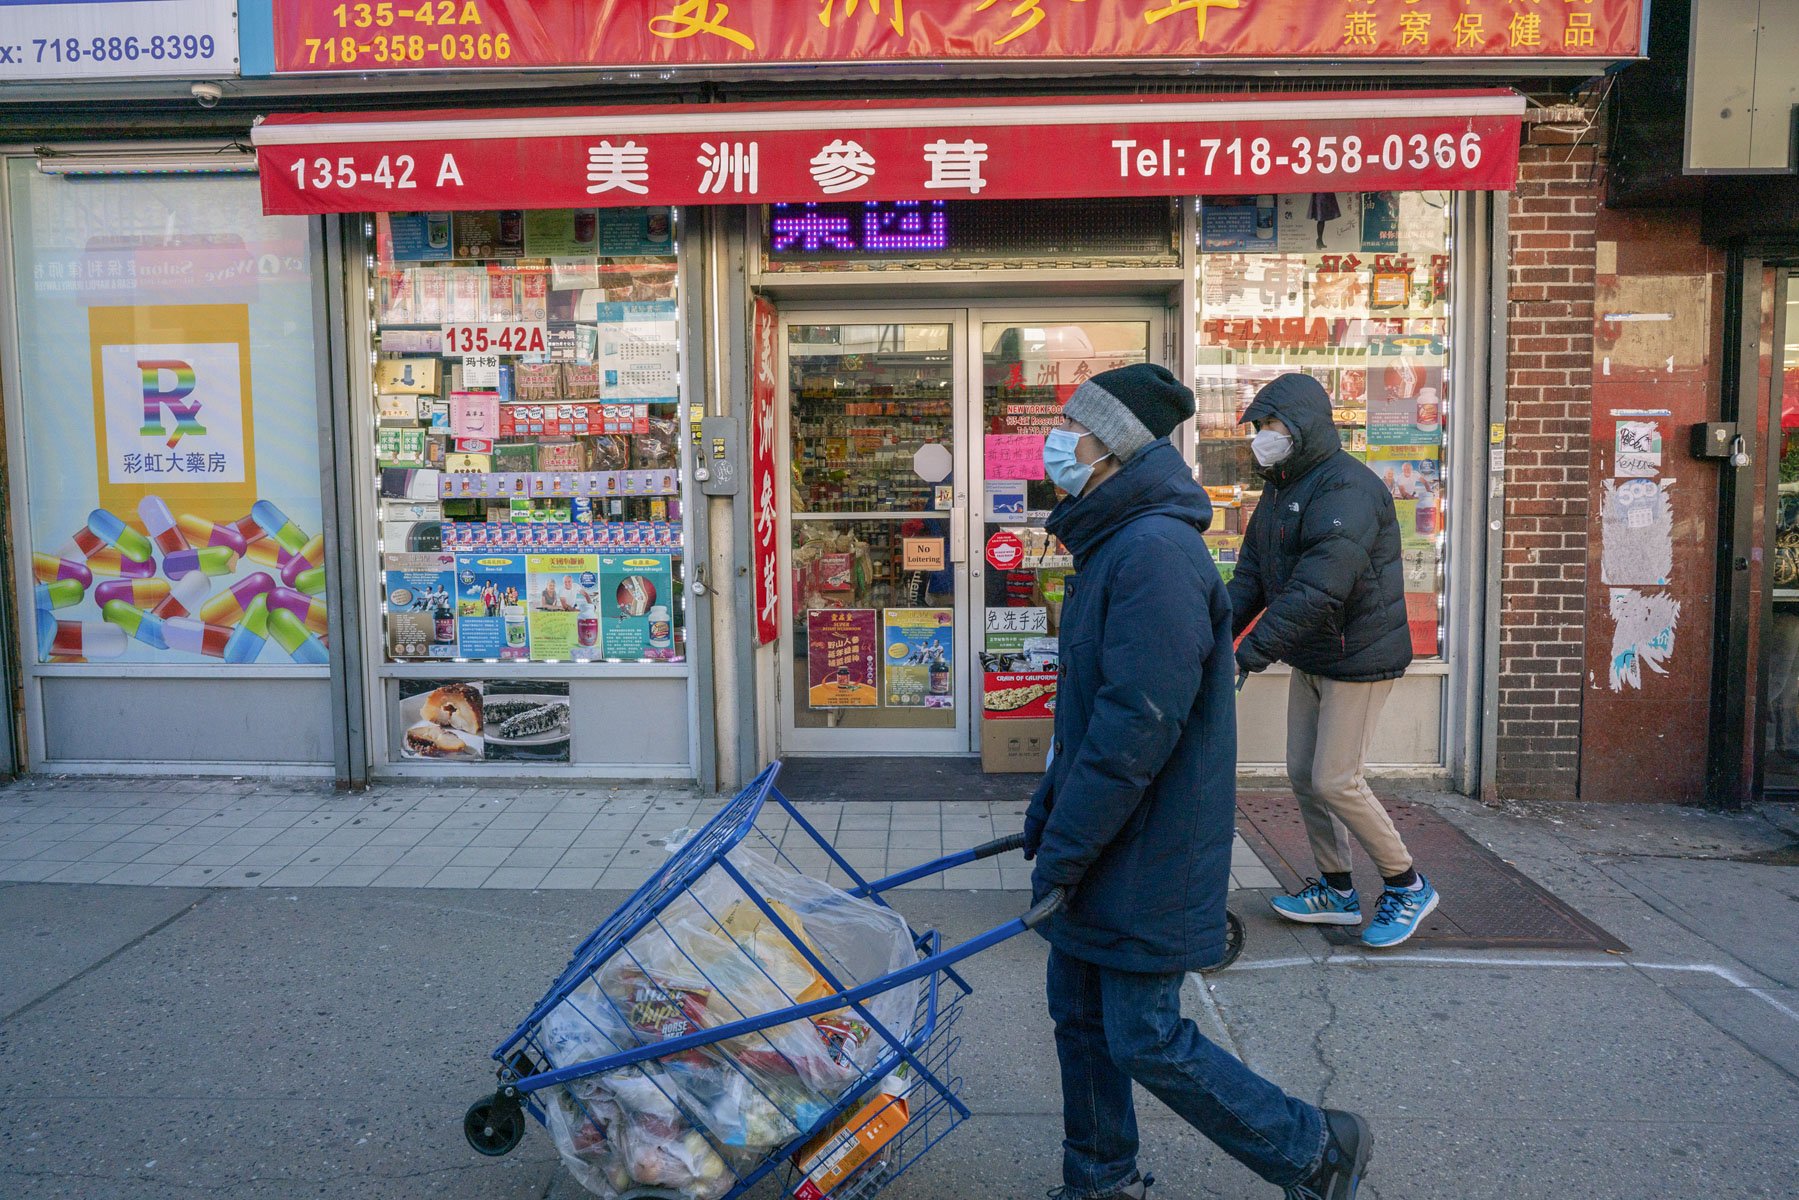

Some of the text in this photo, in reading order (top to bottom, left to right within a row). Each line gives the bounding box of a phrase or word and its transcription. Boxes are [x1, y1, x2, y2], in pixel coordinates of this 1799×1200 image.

[332, 1, 483, 28] 135-42A
[1343, 11, 1595, 47] 燕窝保健品
[33, 33, 215, 63] 718-886-8399
[304, 33, 511, 64] 718-358-0366
[586, 139, 989, 194] 美洲參茸
[1112, 132, 1483, 177] Tel: 718-358-0366
[290, 153, 464, 190] 135-42 A
[446, 327, 545, 353] 135-42A
[465, 356, 497, 368] 玛卡粉
[1007, 405, 1024, 414] NEW
[1025, 405, 1044, 414] YORK
[123, 452, 227, 474] 彩虹大藥房
[907, 556, 941, 564] Loitering
[917, 545, 931, 553] No
[987, 610, 1047, 630] 免洗手液
[662, 1020, 689, 1034] HORSE
